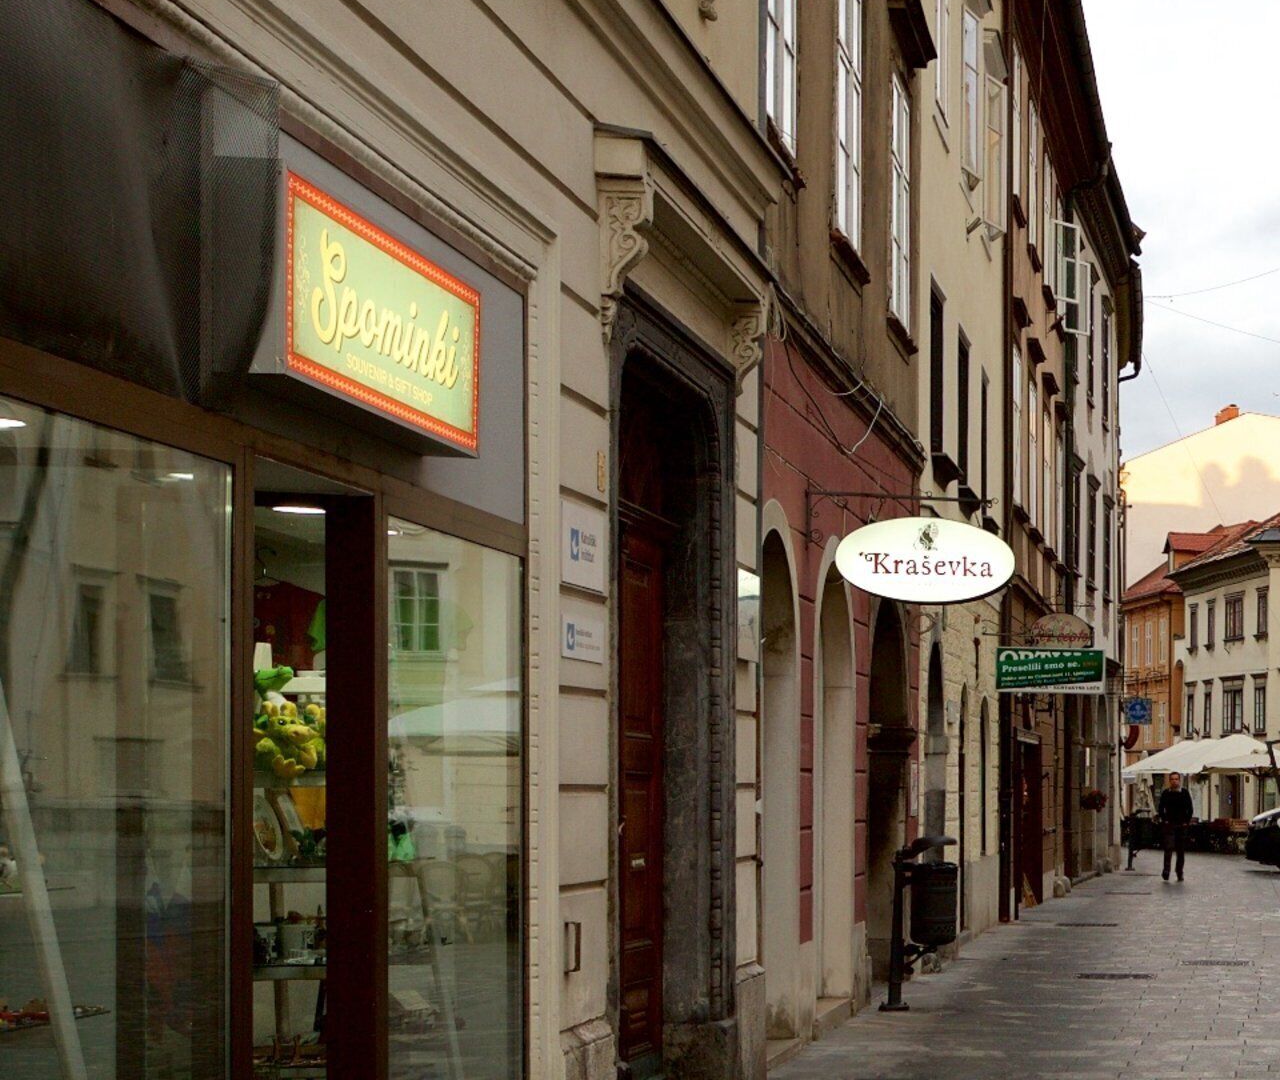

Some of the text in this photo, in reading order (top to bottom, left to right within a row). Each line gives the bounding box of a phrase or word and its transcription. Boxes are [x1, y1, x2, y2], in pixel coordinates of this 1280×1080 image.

[311, 228, 460, 389] Spominki
[346, 353, 387, 384] SOUVENIR
[395, 377, 411, 395] GIFT
[412, 385, 433, 406] SHOP
[860, 551, 993, 578] Kraševka
[1002, 662, 1041, 673] Preselili
[1044, 662, 1064, 670] smo
